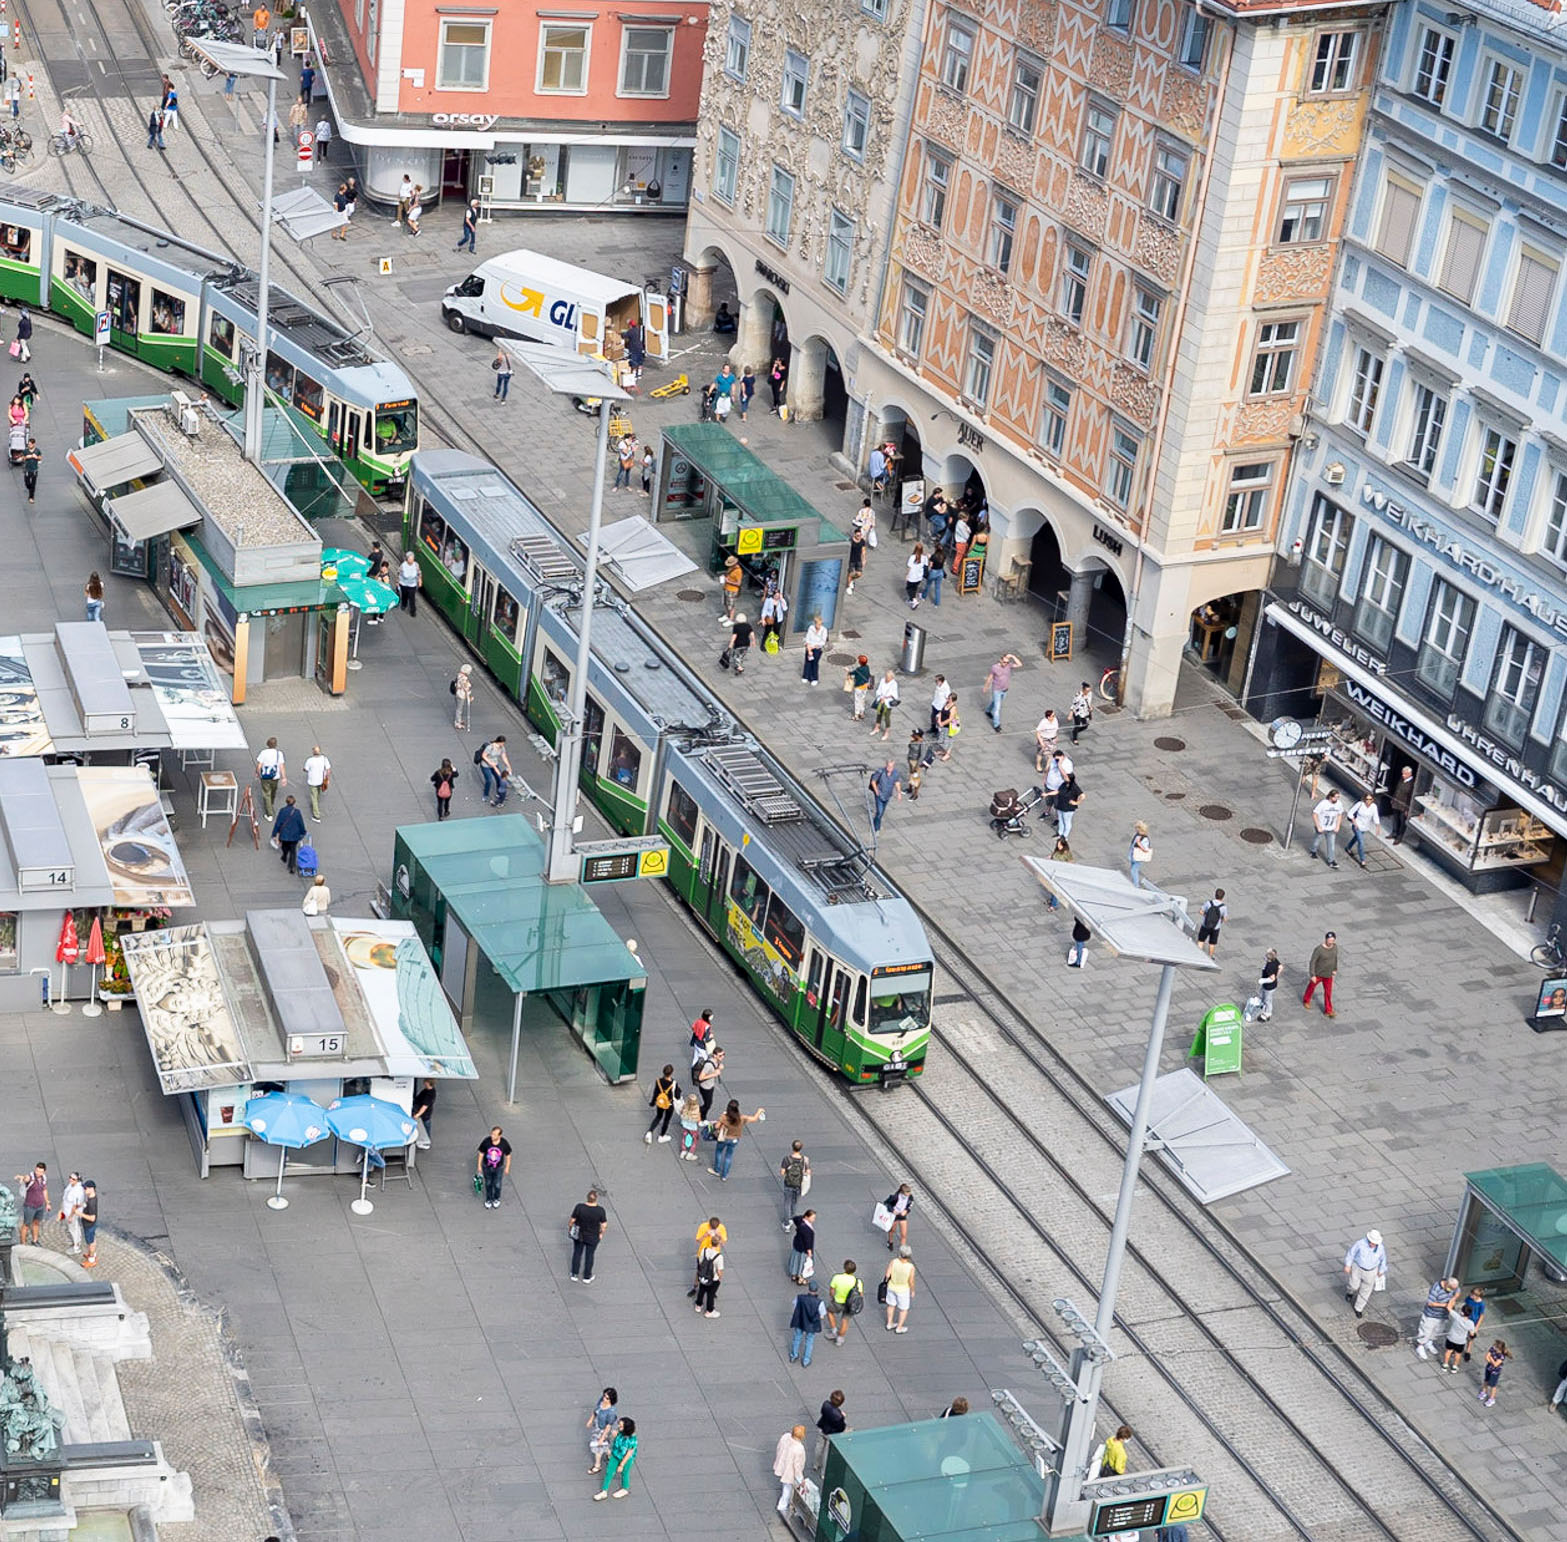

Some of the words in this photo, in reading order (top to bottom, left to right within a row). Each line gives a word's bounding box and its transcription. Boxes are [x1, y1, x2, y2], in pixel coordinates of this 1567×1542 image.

[432, 113, 500, 131] orsay
[550, 300, 577, 332] GL
[958, 422, 984, 452] AUER
[1092, 524, 1123, 557] LUSH
[1289, 600, 1387, 676] JUWELIER
[120, 717, 129, 729] 8
[1346, 679, 1476, 786] WEIKHARD
[48, 872, 67, 885] 14
[319, 1038, 338, 1051] 15
